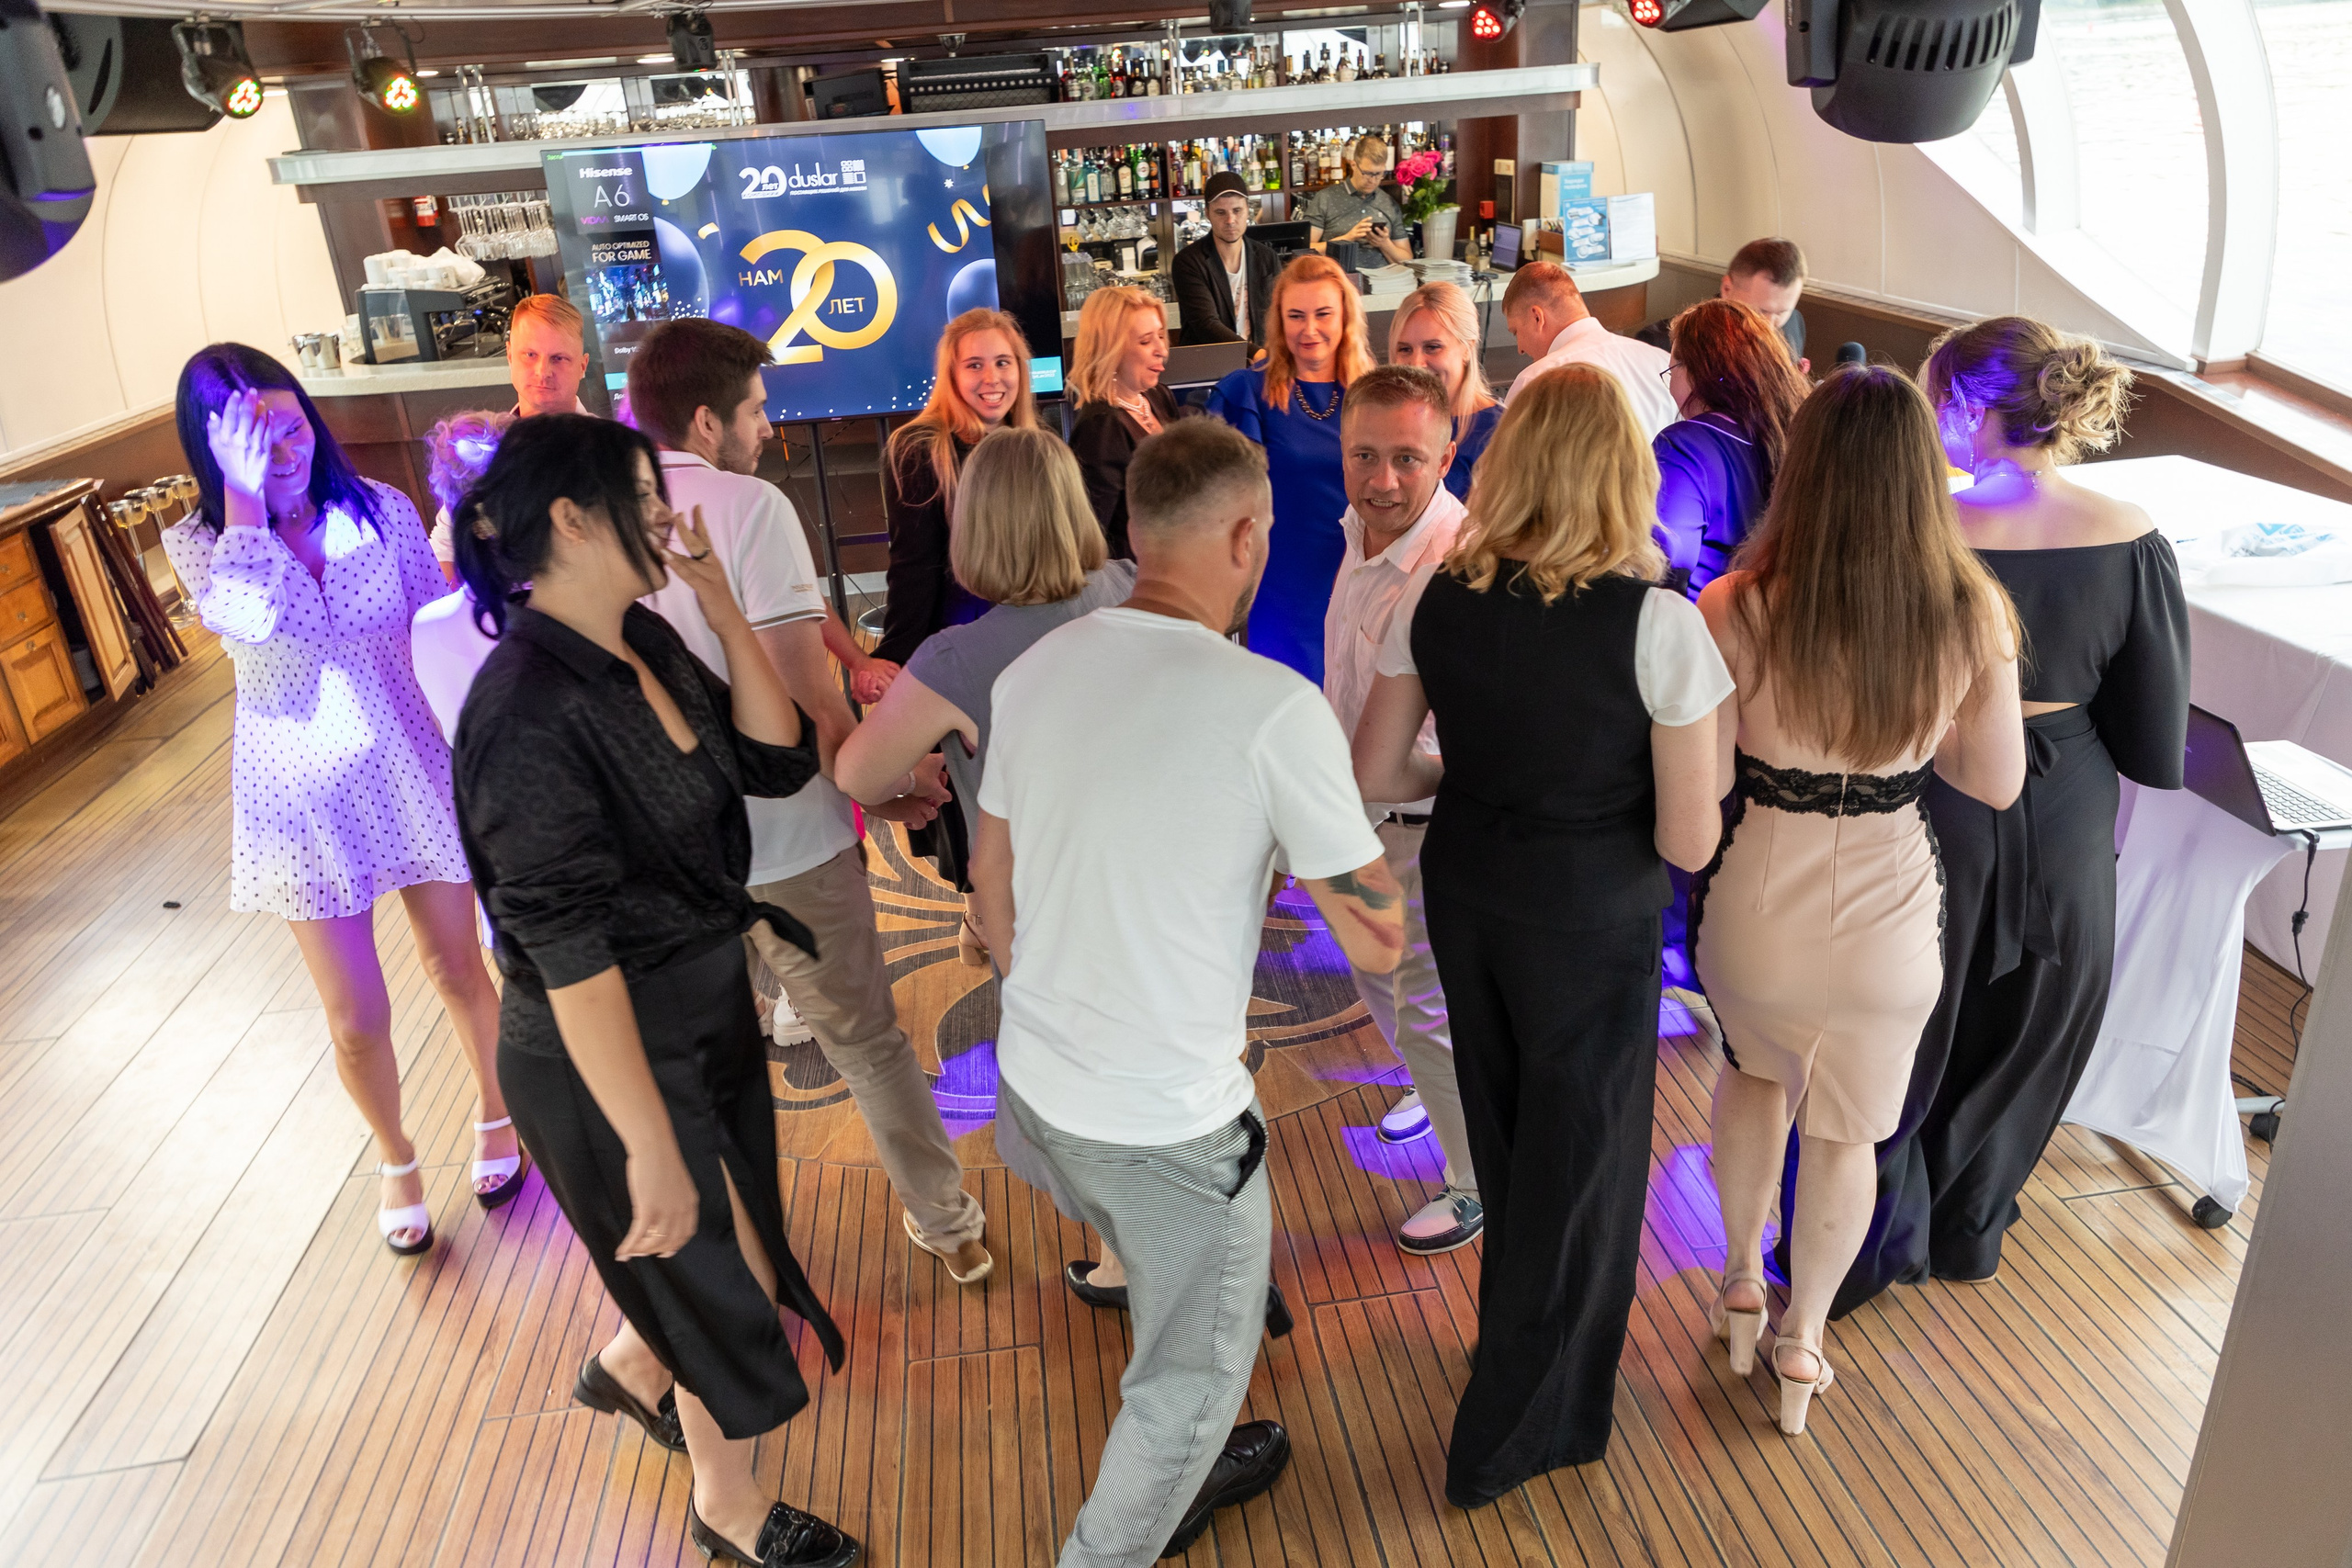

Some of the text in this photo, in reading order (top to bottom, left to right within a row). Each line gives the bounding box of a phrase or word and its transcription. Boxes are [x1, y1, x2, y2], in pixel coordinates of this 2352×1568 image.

[579, 167, 633, 178] Hisense
[788, 162, 838, 188] duslar
[594, 184, 630, 208] A6
[614, 213, 638, 223] SMART
[638, 212, 649, 221] OS
[592, 240, 650, 252] AUTO OPTIMIZED
[592, 248, 651, 264] FOR GAME
[738, 229, 898, 367] НАМ 20 ЛЕТ
[614, 346, 630, 355] Dolby
